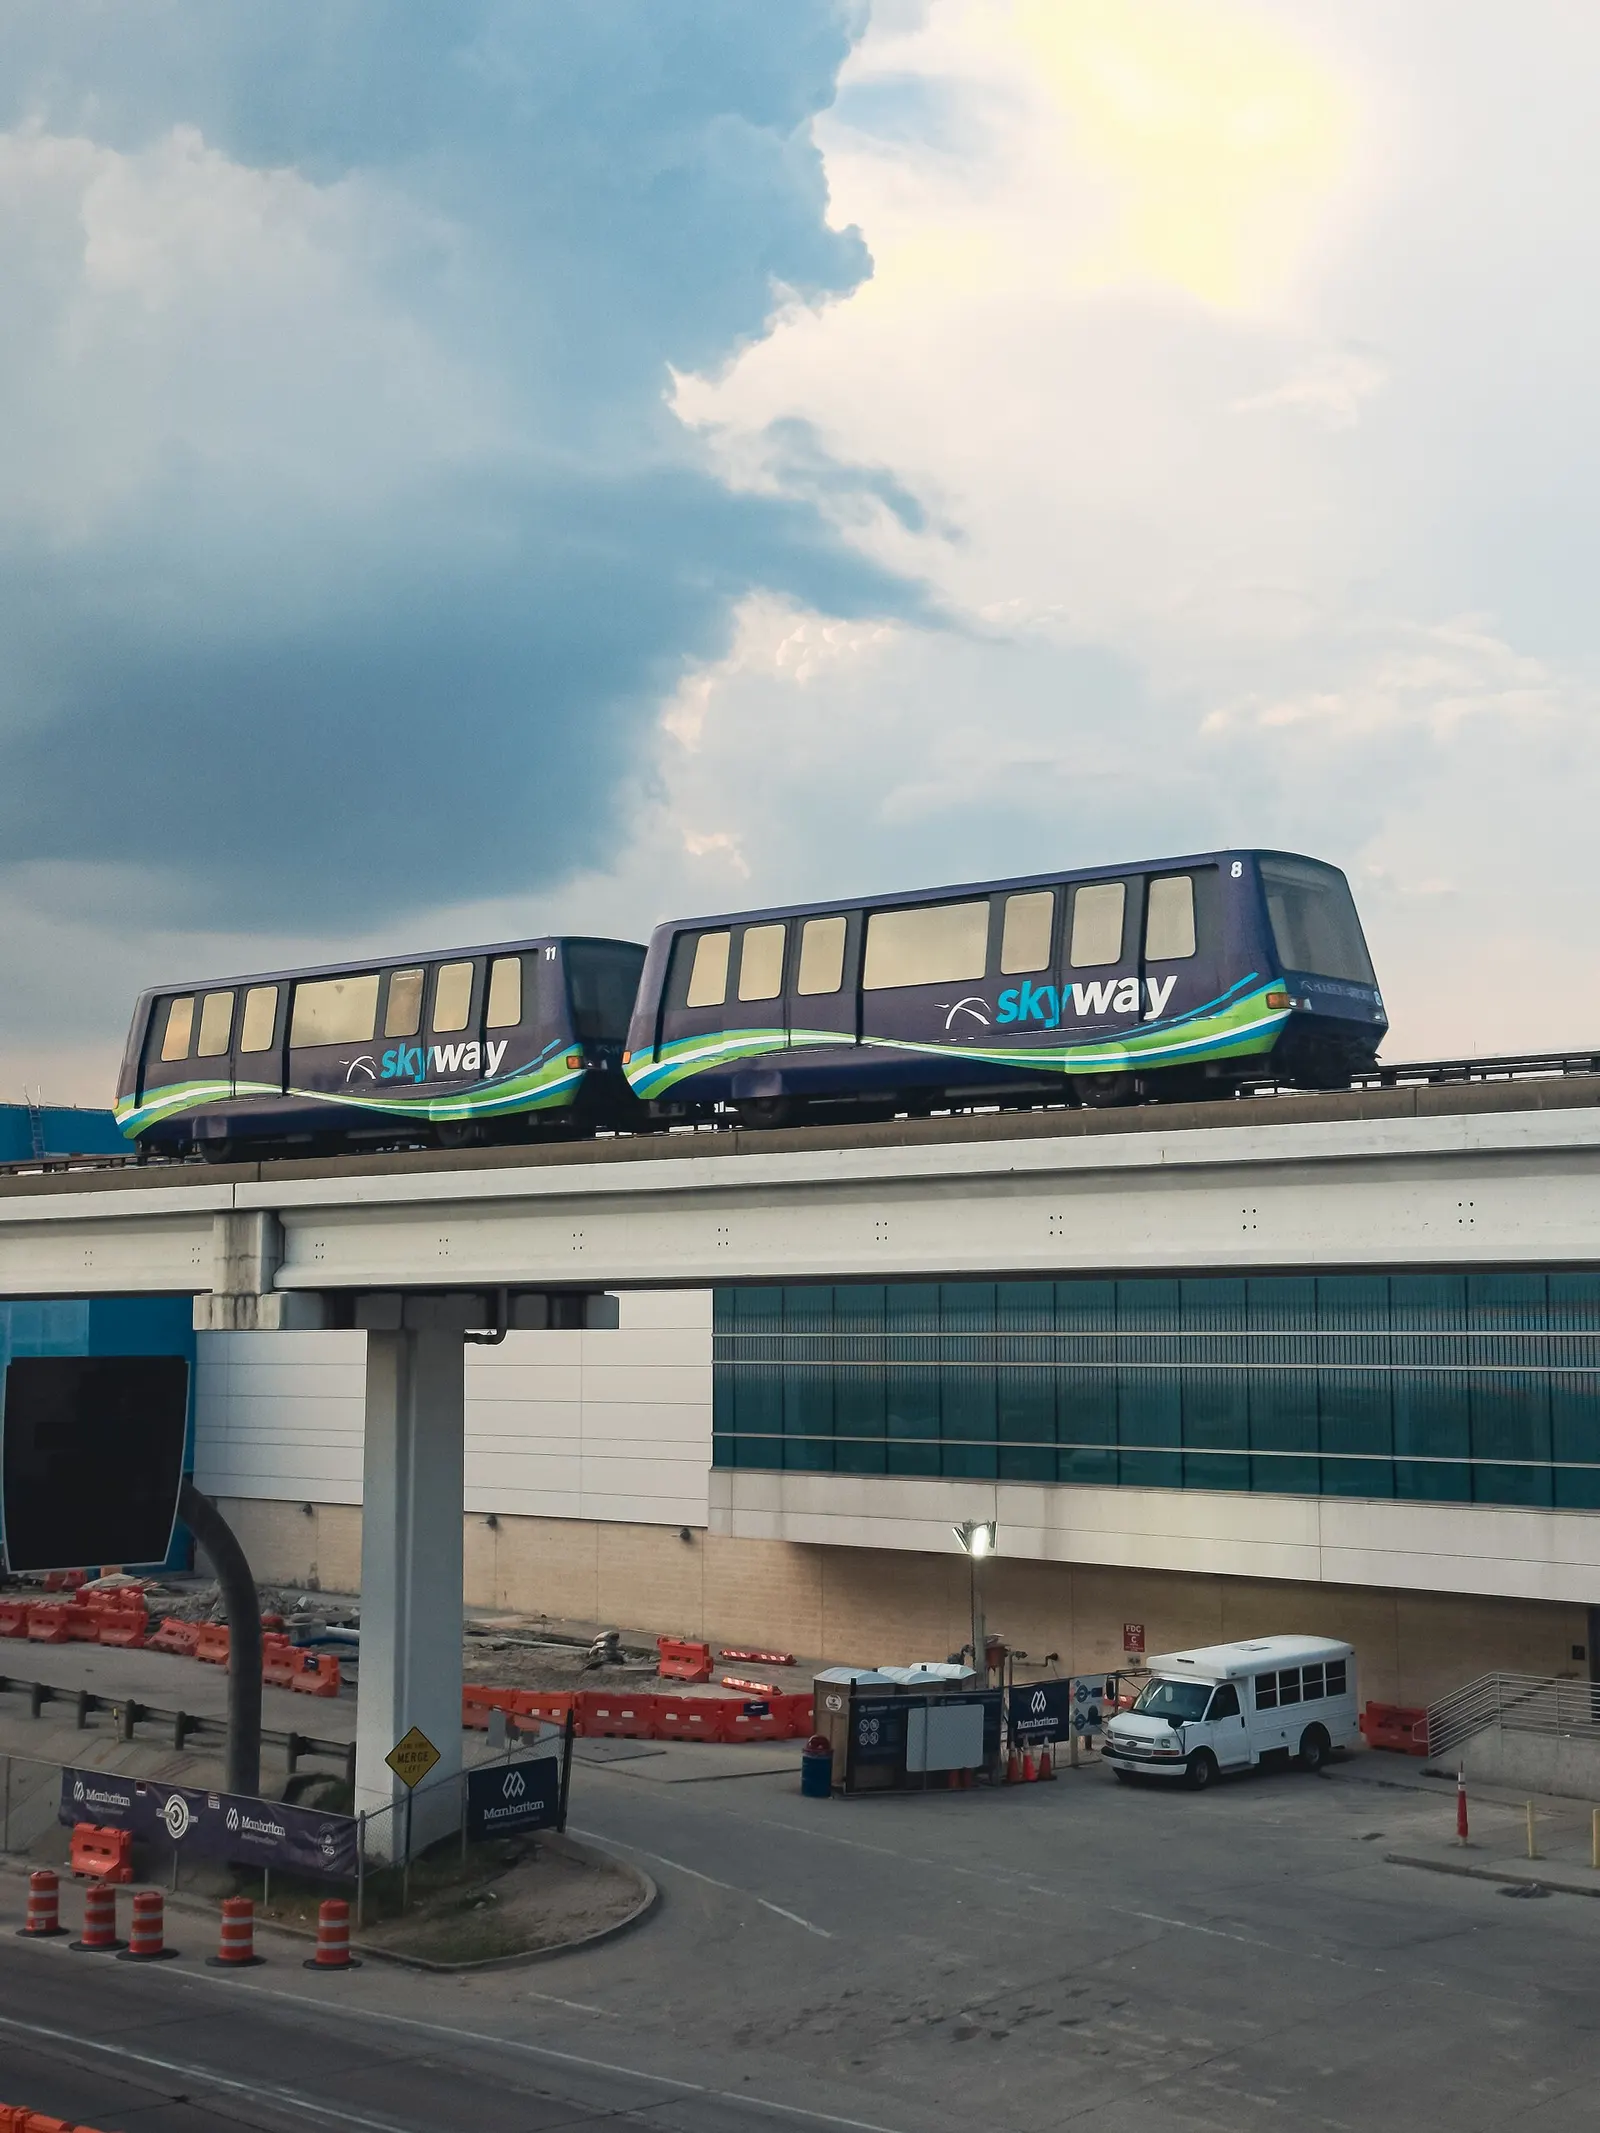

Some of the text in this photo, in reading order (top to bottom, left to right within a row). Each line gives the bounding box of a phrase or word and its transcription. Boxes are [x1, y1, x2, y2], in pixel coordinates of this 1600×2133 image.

[1230, 861, 1243, 878] 8
[545, 946, 556, 961] 11
[995, 975, 1178, 1029] skyway
[380, 1040, 508, 1083] skyway
[1125, 1624, 1142, 1633] FDC
[397, 1751, 429, 1763] MERGE
[86, 1788, 131, 1807] Manhattan
[484, 1800, 545, 1820] Manhattan
[242, 1815, 286, 1836] Manhattan
